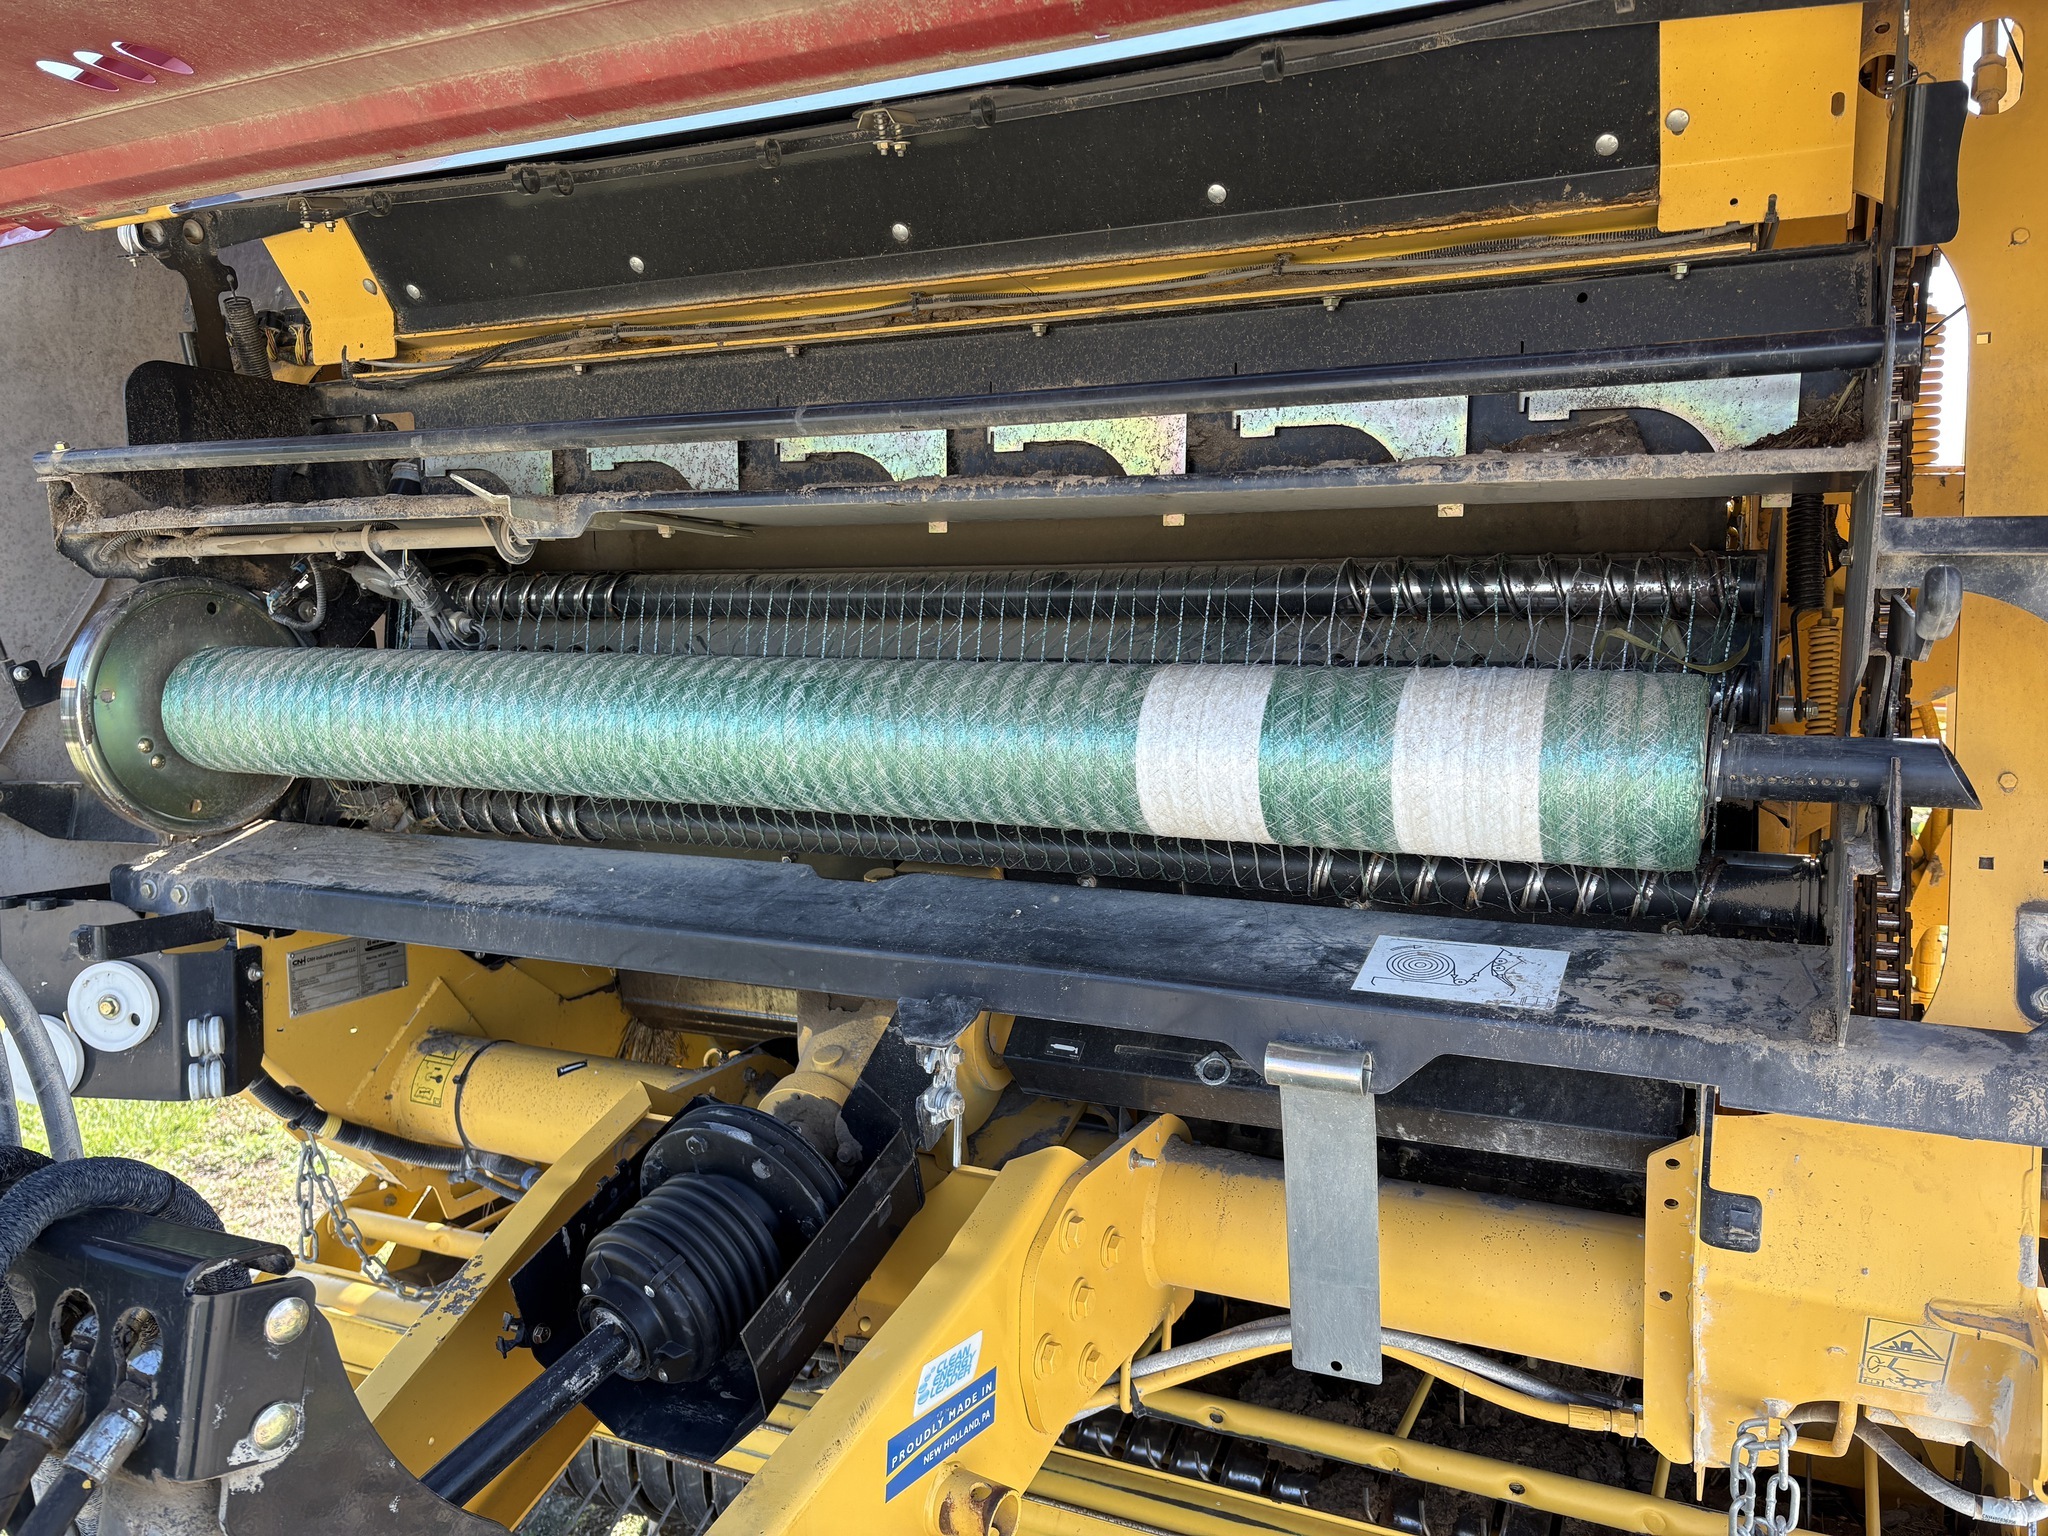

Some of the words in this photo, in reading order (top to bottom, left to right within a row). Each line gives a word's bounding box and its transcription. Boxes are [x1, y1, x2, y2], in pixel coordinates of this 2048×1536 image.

[292, 955, 307, 966] CNH
[933, 1350, 977, 1387] ENERGY
[936, 1344, 971, 1374] CLEAN
[930, 1364, 972, 1398] LEADER
[891, 1417, 944, 1469] PROUDLY
[948, 1391, 978, 1421] MADE
[981, 1381, 993, 1397] IN
[923, 1443, 943, 1466] NEW
[943, 1418, 981, 1451] HOLLAND,
[981, 1409, 991, 1423] PA
